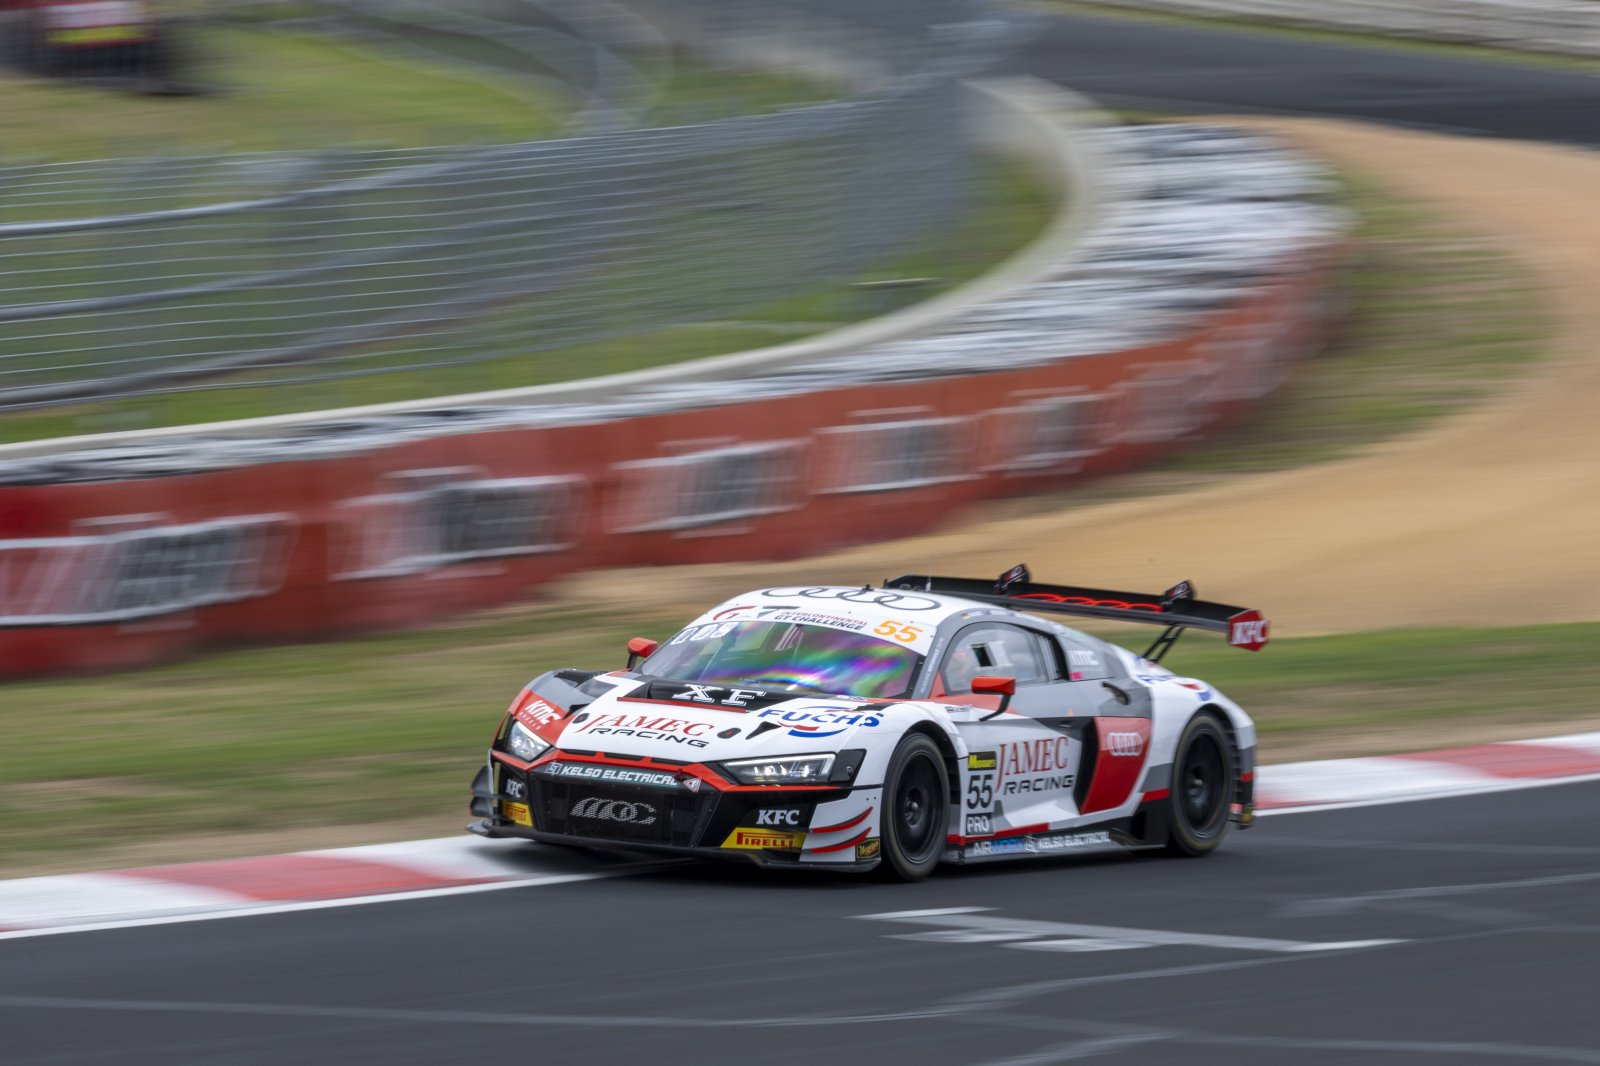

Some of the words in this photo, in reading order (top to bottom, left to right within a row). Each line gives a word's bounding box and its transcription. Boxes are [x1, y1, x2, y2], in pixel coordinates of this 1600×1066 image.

[780, 611, 868, 626] INTERCONTINENTAL
[792, 615, 864, 631] CHALLENGE
[873, 620, 924, 643] 55
[1231, 620, 1267, 645] KFC
[574, 714, 715, 736] JAMEC
[757, 709, 884, 728] FUCHS
[588, 727, 709, 748] RACING
[994, 736, 1069, 793] JAMEC
[561, 766, 601, 778] KELSO
[602, 769, 678, 786] ELECTRICAL
[1003, 775, 1074, 795] RACING
[505, 779, 522, 798] KFC
[967, 774, 993, 809] 55
[756, 809, 800, 825] KFC
[967, 816, 989, 833] PRO
[736, 832, 794, 849] PIRELLI
